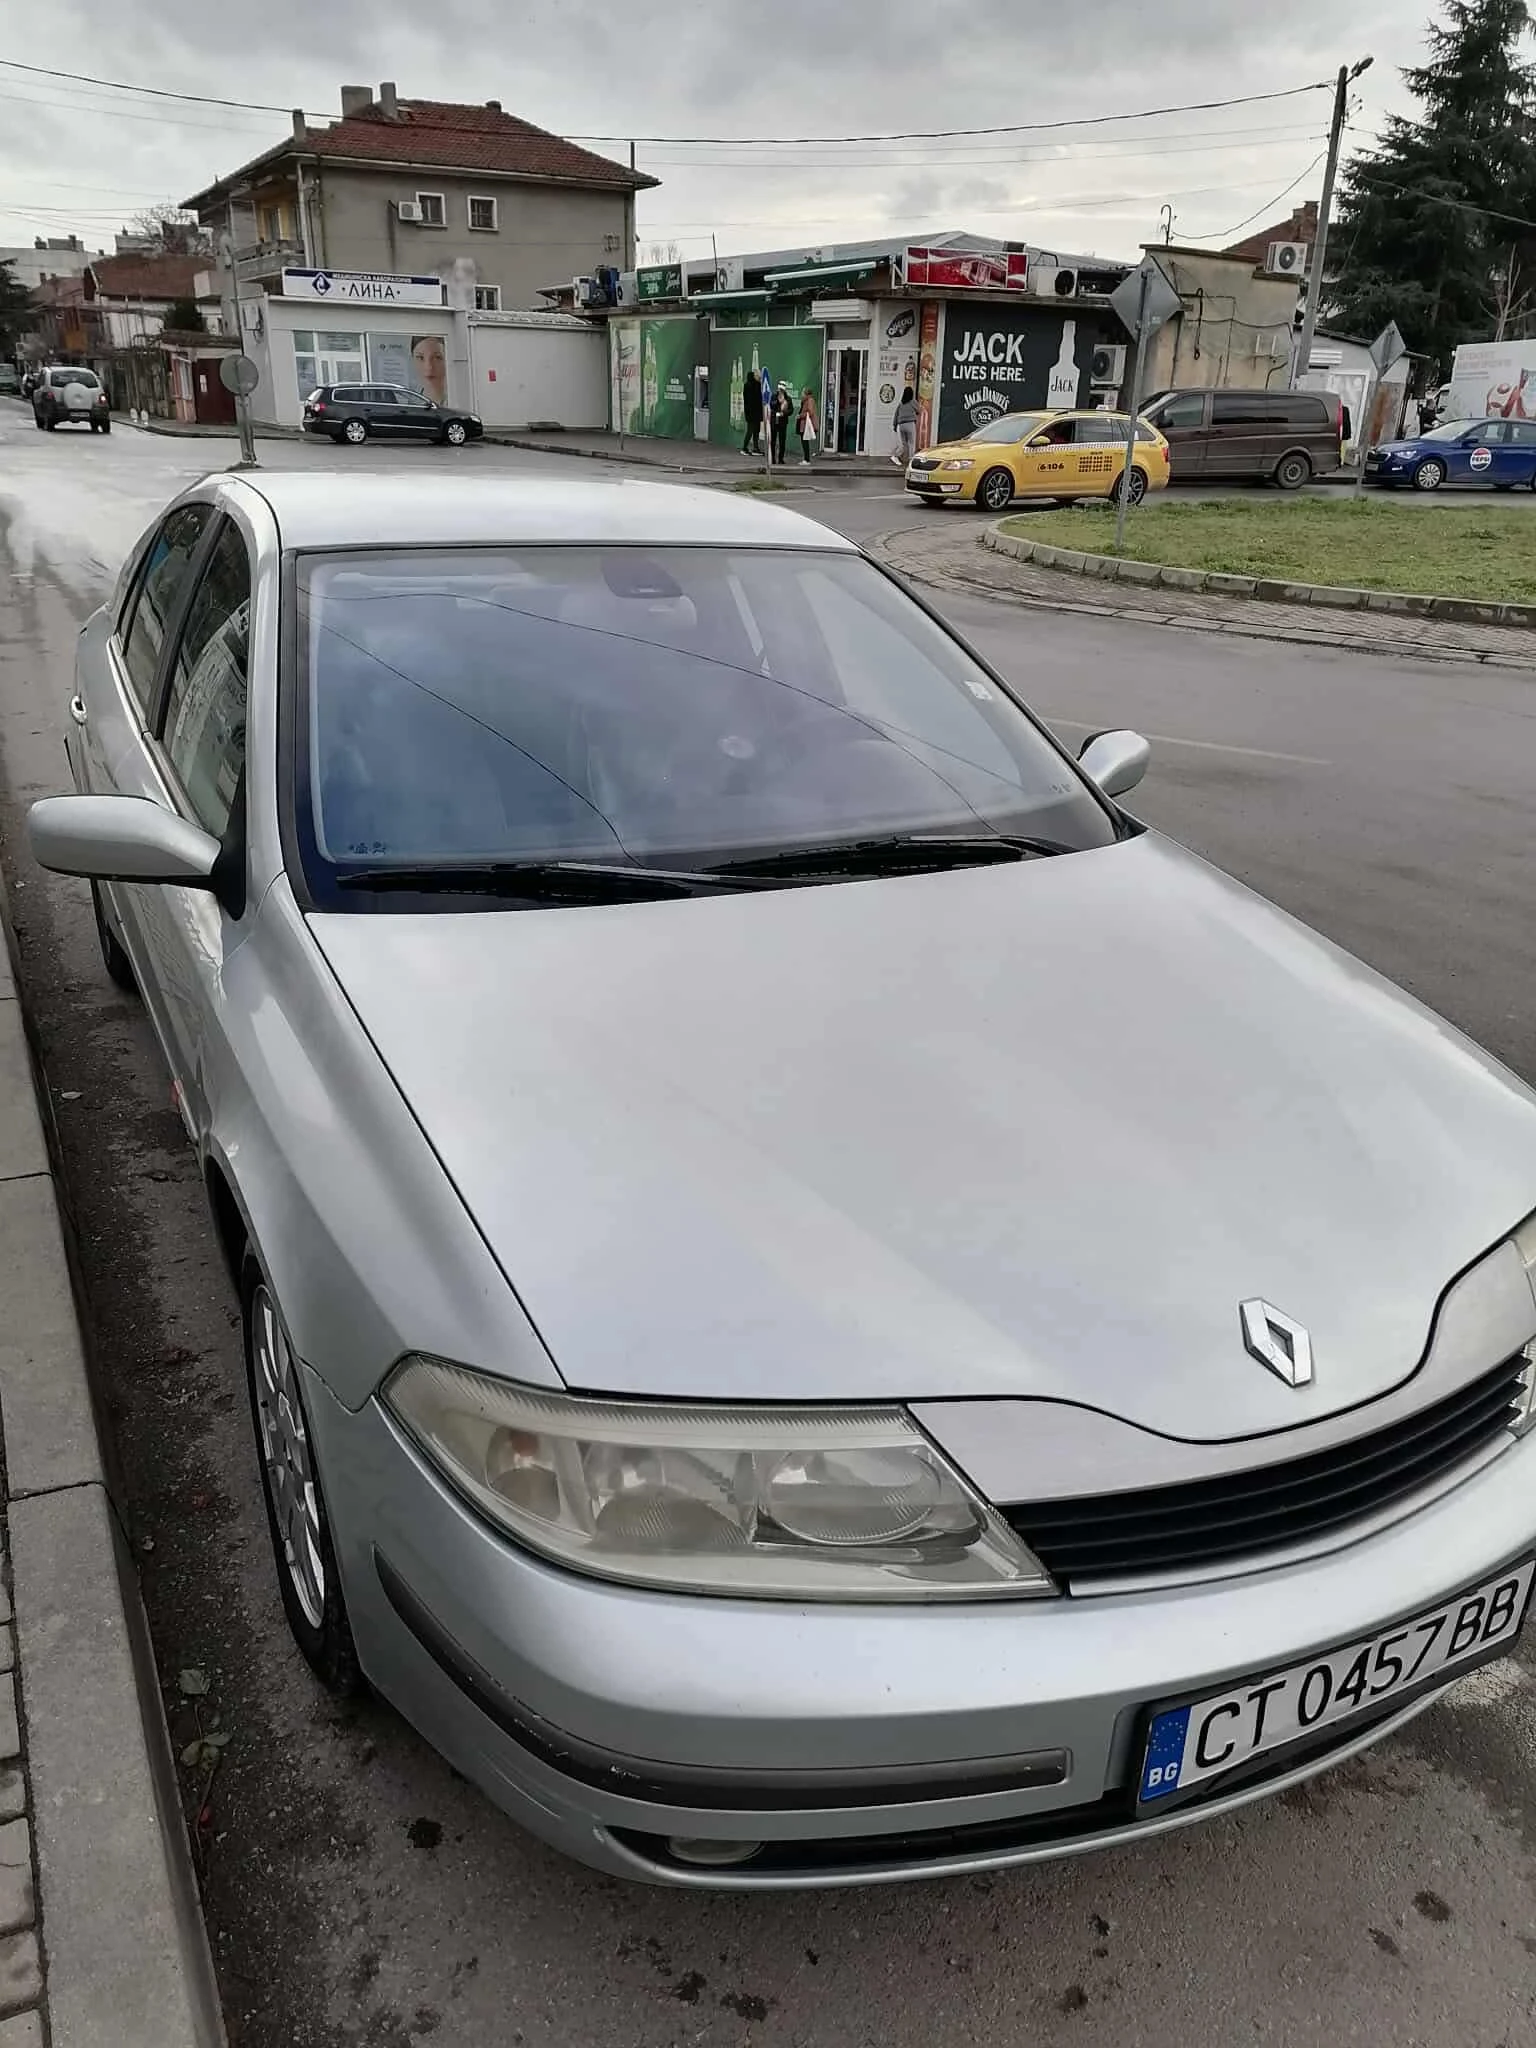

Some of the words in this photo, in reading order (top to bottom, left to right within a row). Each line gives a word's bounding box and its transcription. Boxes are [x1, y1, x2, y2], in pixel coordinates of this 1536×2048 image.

[953, 331, 1025, 364] JACK
[952, 365, 987, 381] LIVES
[1051, 375, 1073, 393] JACK
[1194, 1680, 1286, 1770] CT
[1296, 1614, 1448, 1728] 0457
[1446, 1578, 1520, 1660] BB
[1147, 1761, 1178, 1787] BG
